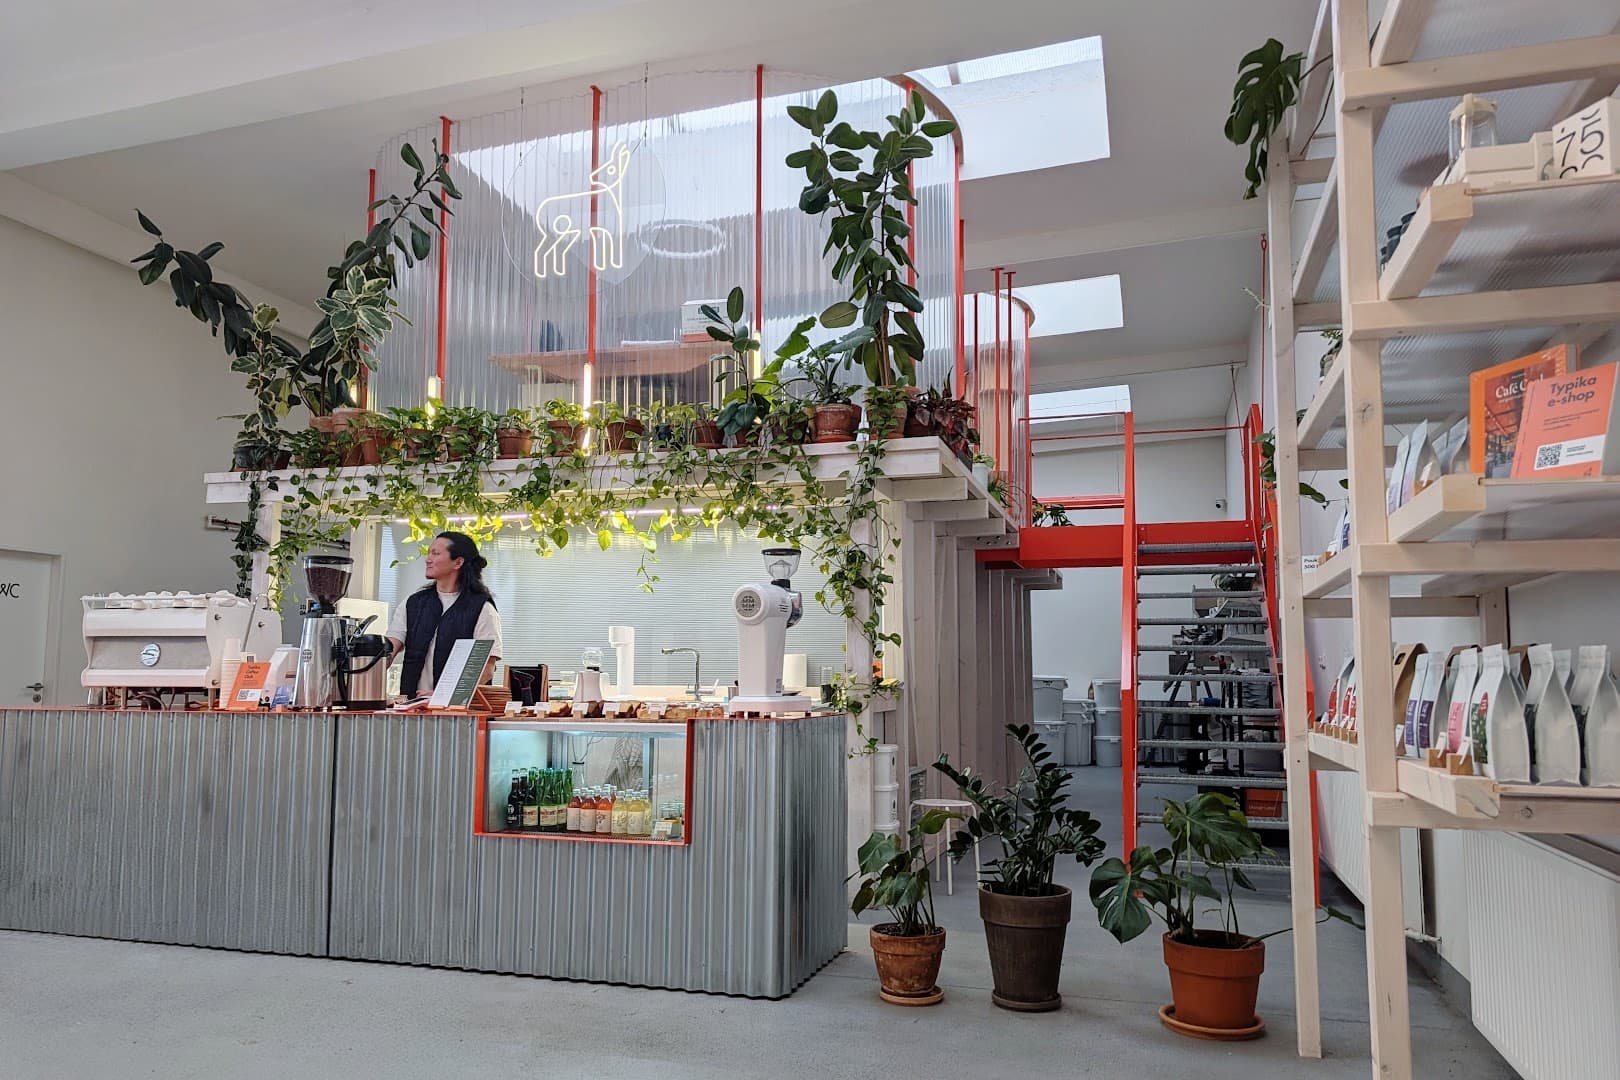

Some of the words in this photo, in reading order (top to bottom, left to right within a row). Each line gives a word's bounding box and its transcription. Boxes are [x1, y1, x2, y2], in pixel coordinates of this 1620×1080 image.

[1495, 381, 1518, 399] Café
[1551, 376, 1597, 394] Typika
[1547, 390, 1595, 408] e-shop
